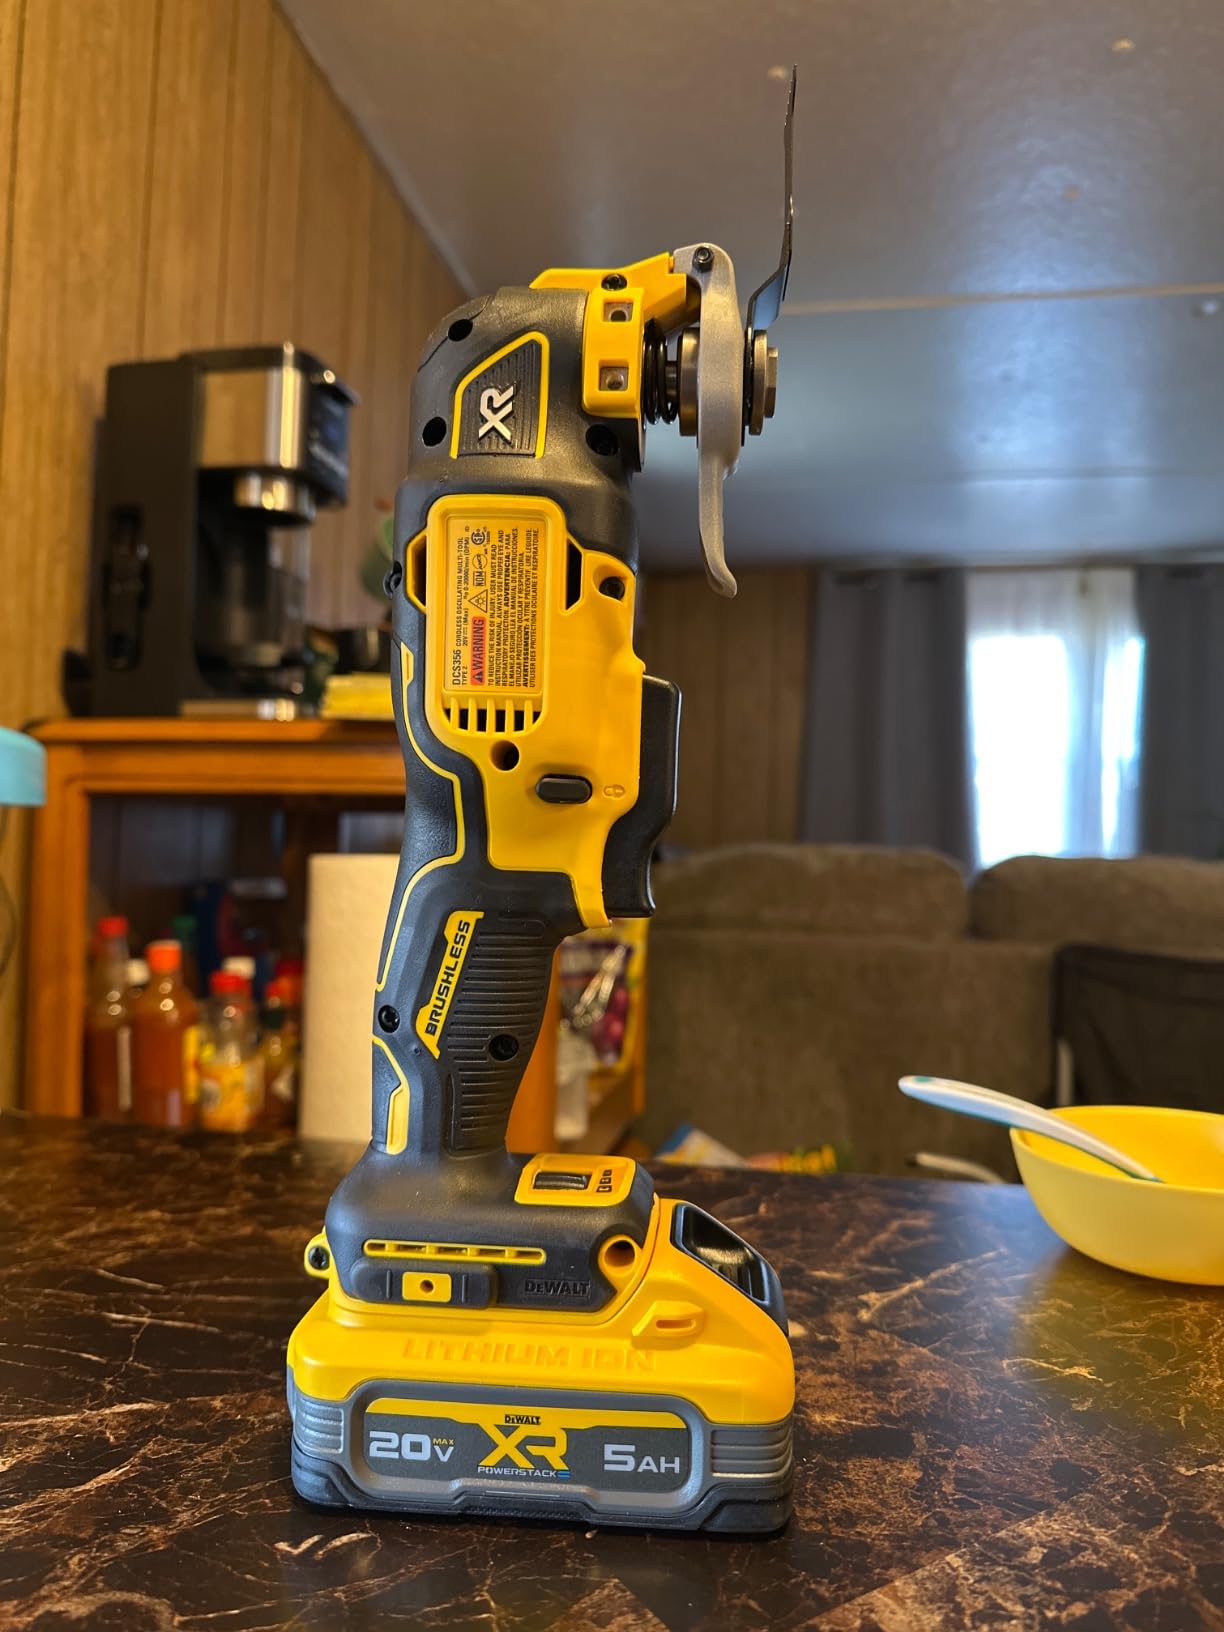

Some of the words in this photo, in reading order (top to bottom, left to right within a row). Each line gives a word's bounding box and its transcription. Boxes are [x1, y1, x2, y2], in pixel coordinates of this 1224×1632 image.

[479, 386, 514, 441] XR
[474, 571, 484, 586] NOM
[472, 619, 484, 670] WARNING
[452, 650, 461, 685] DCS356
[425, 919, 470, 1036] BRUSHLESS
[402, 1337, 568, 1367] LITHIUM
[583, 1346, 656, 1371] ION
[433, 1437, 454, 1446] MAX
[479, 1423, 570, 1470] XR
[477, 1466, 557, 1478] POWERSTACK
